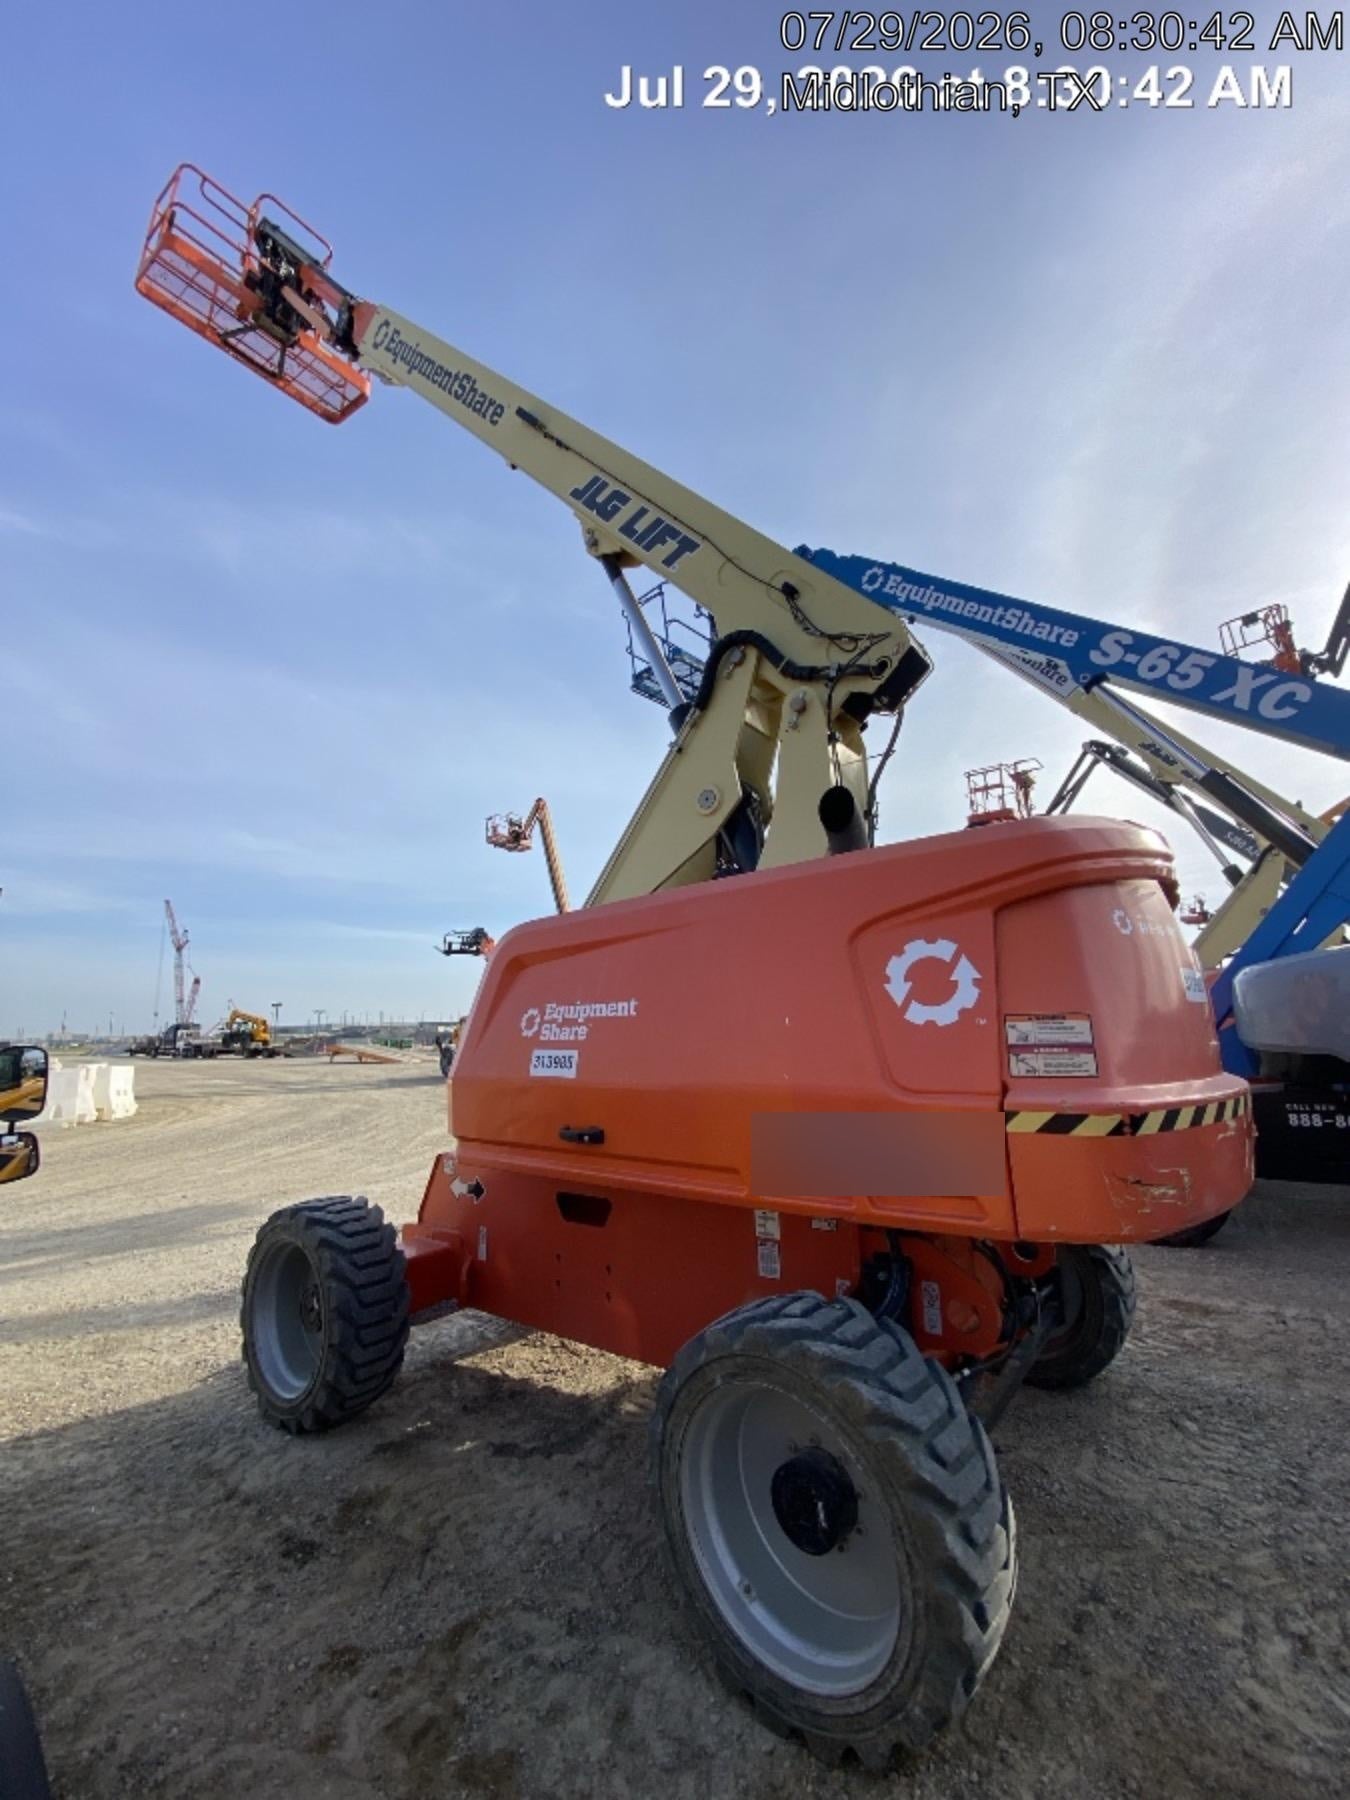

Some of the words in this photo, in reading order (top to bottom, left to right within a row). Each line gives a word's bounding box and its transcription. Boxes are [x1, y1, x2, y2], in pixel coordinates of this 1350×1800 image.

[385, 328, 505, 427] EquipmentShare
[569, 475, 633, 524] JLG
[617, 506, 702, 569] LIFT
[884, 574, 1080, 648] EquipmentShare
[1089, 631, 1217, 691] S-65
[1211, 671, 1312, 720] XC
[539, 1023, 589, 1041] Share
[544, 997, 638, 1022] Equipment
[1288, 1113, 1350, 1129] 888-8
